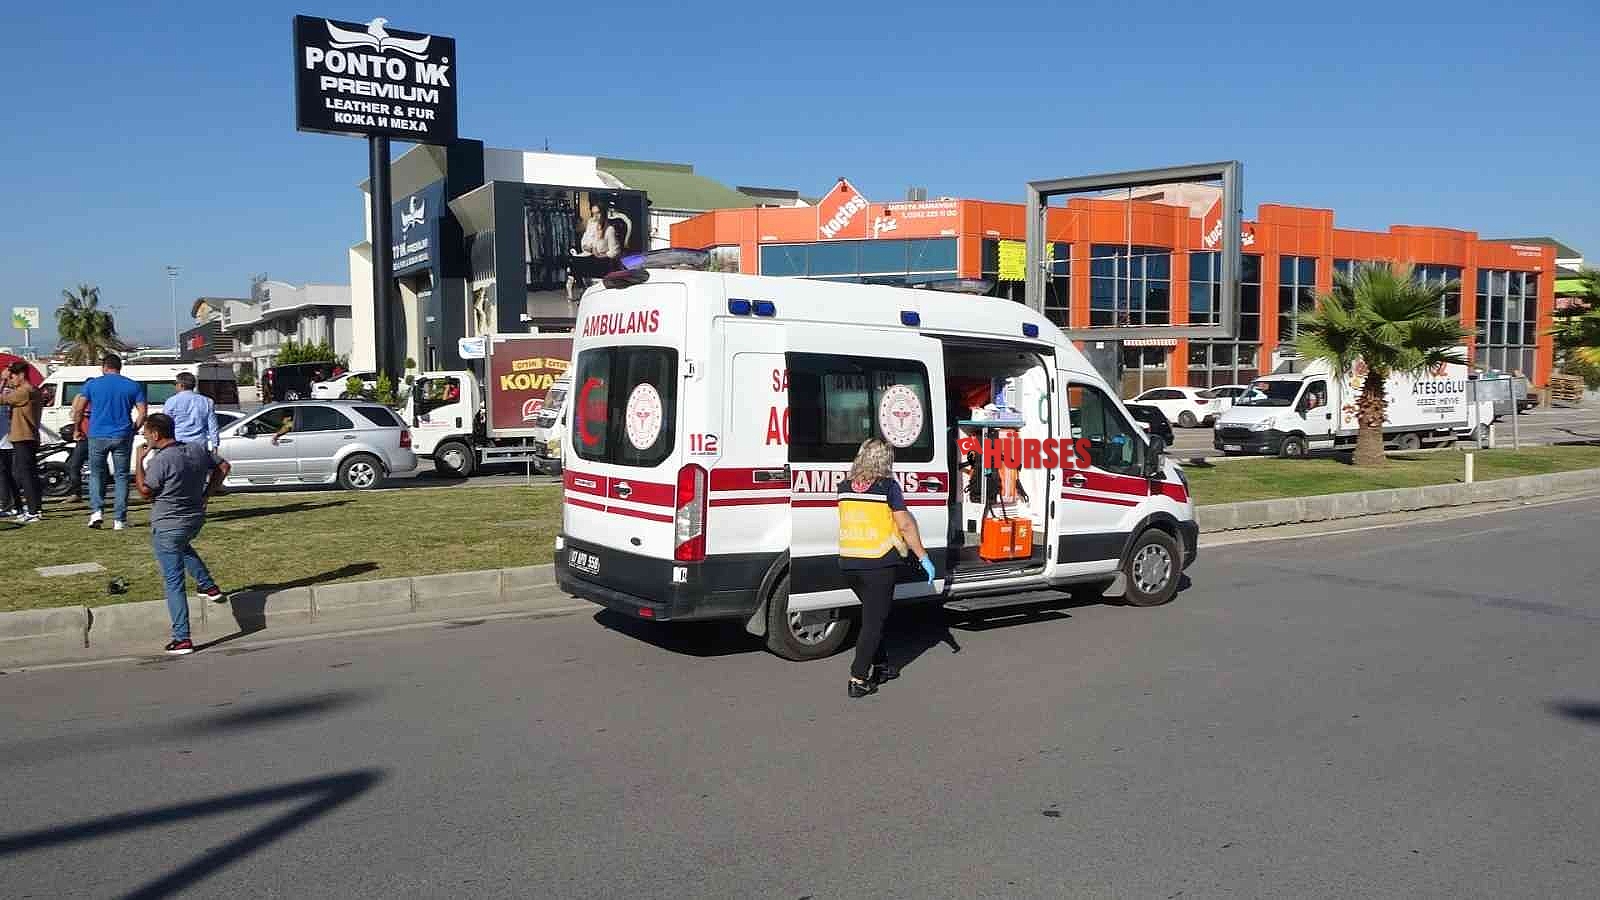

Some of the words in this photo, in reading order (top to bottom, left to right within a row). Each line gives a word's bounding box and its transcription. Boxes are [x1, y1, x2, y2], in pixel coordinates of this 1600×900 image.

[305, 46, 406, 81] PONTO
[319, 75, 439, 104] PREMIUM
[325, 97, 391, 115] LEATHER
[393, 104, 404, 116] &
[407, 106, 435, 120] FUR
[334, 112, 376, 126] КОЖА
[378, 117, 388, 127] И
[390, 118, 428, 132] МЕХА
[583, 309, 660, 337] AMBULANS
[690, 433, 718, 451] 112
